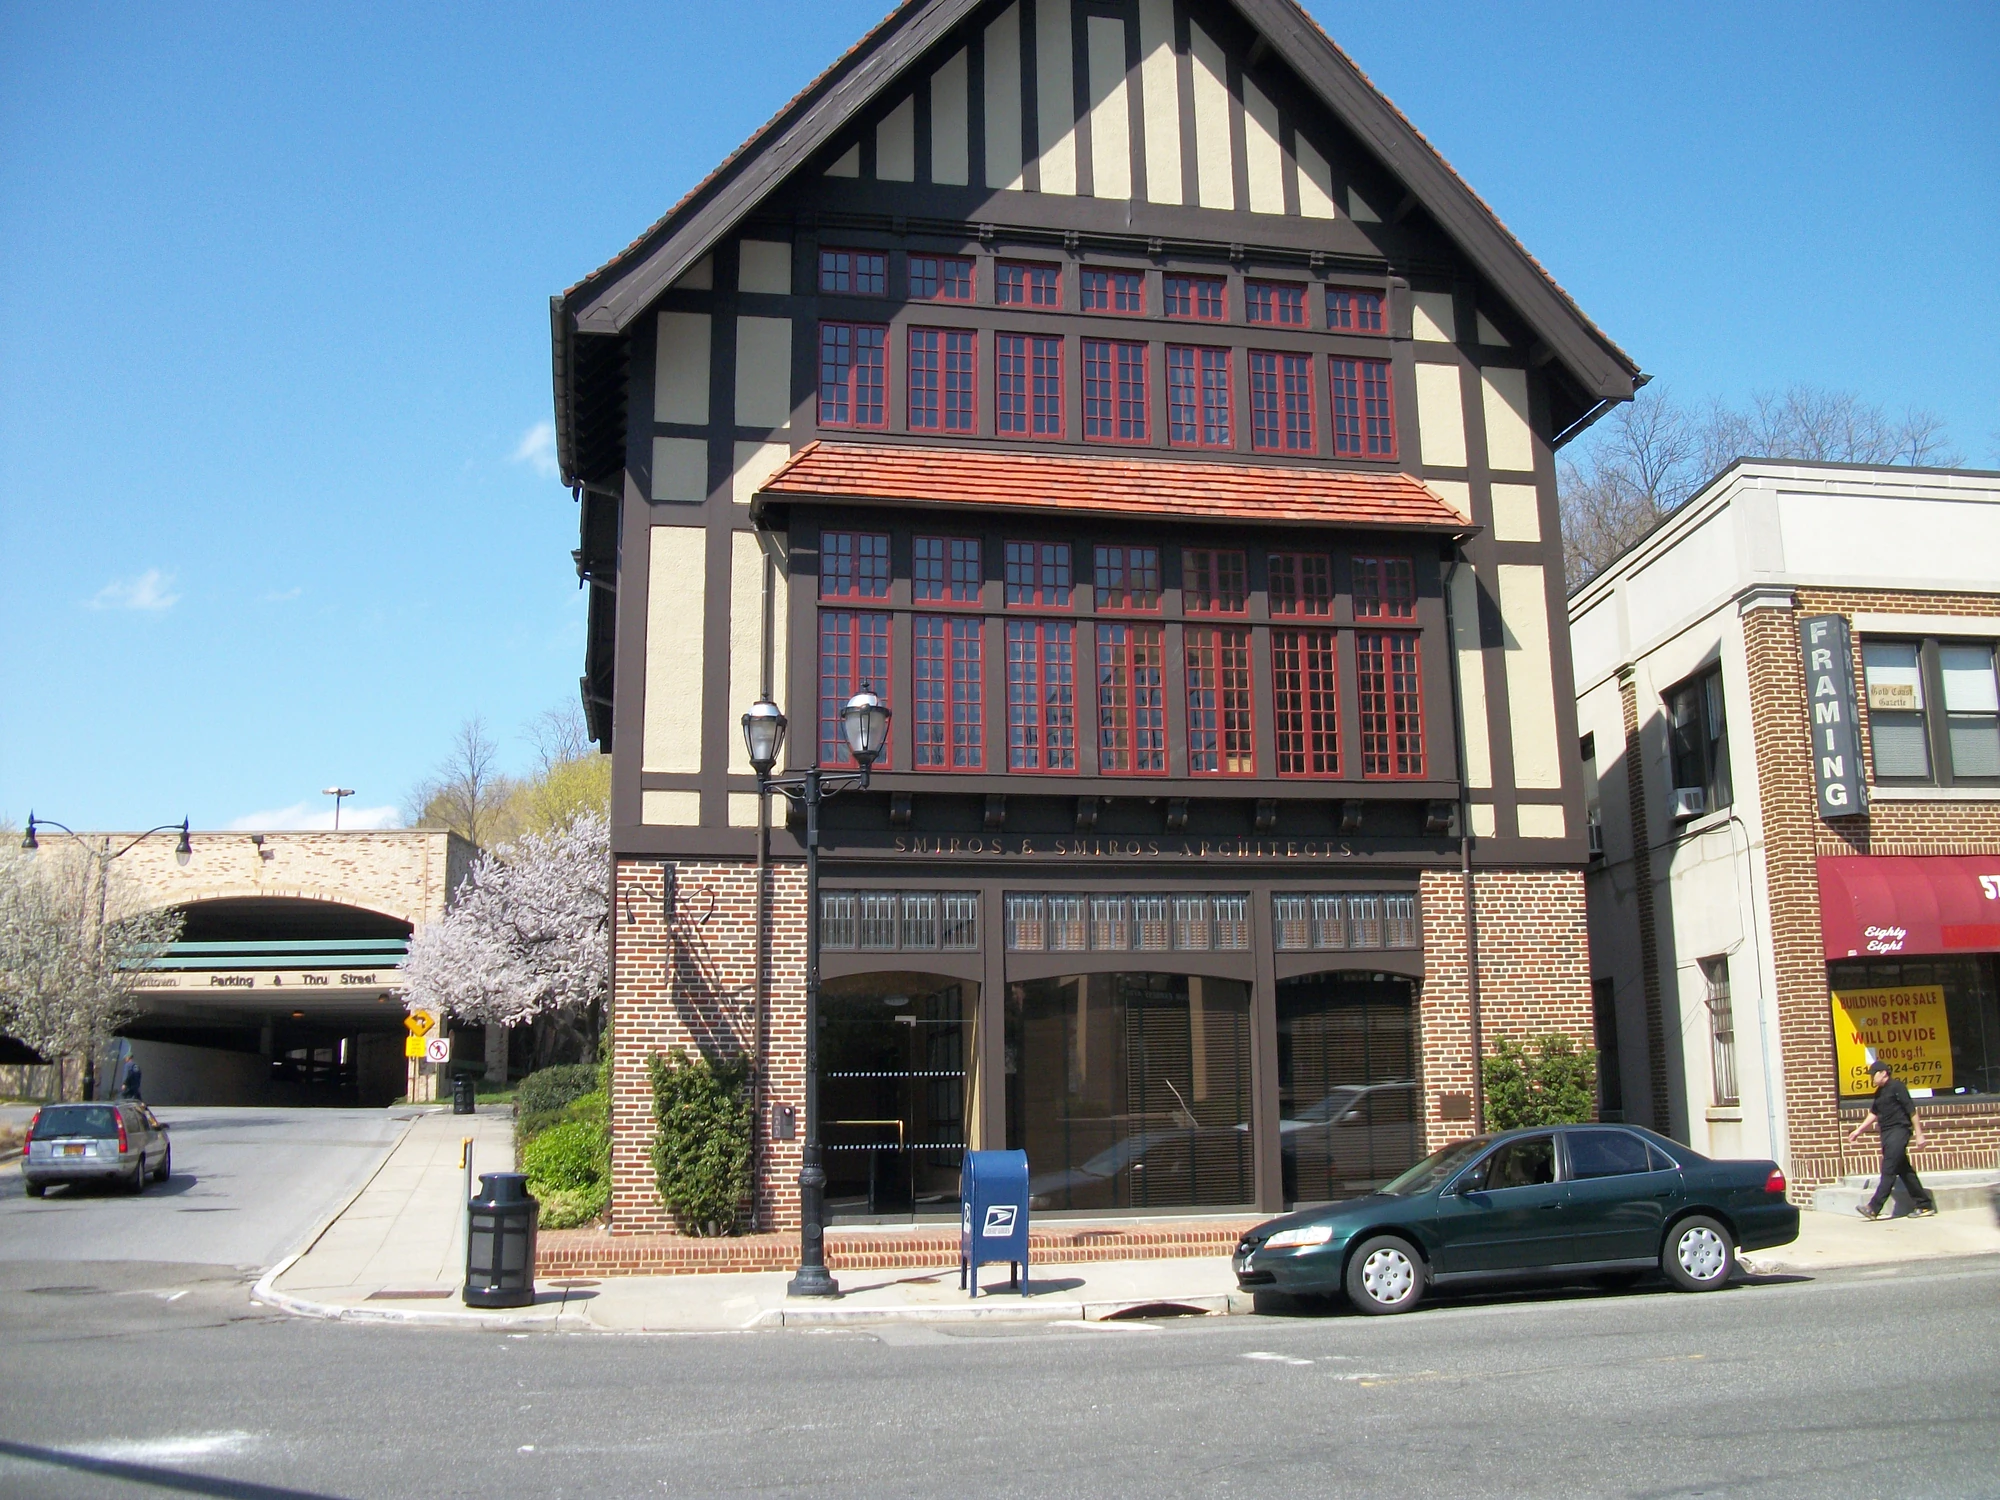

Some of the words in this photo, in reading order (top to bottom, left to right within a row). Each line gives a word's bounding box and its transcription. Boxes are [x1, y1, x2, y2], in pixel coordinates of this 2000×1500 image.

[1871, 687, 1889, 696] Gold
[1891, 687, 1913, 696] Coast
[1878, 697, 1907, 707] Gazette
[1809, 621, 1849, 806] FRAMING
[1840, 622, 1867, 807] FRAMING
[894, 836, 1003, 854] SMIROS
[1021, 838, 1035, 855] &
[1055, 839, 1160, 857] SMIROS
[1178, 841, 1352, 858] ARCHITECTS
[1864, 926, 1906, 940] Eighty
[1866, 940, 1903, 954] Eight
[210, 975, 254, 988] Parking
[302, 974, 329, 986] Thru
[340, 972, 377, 985] Street
[1840, 994, 1887, 1010] BUILDING
[1889, 993, 1911, 1007] FOR
[1913, 991, 1937, 1005] SALE
[1881, 1010, 1917, 1026] RENT
[1851, 1029, 1884, 1045] WILL
[1887, 1027, 1937, 1043] DIVIDE
